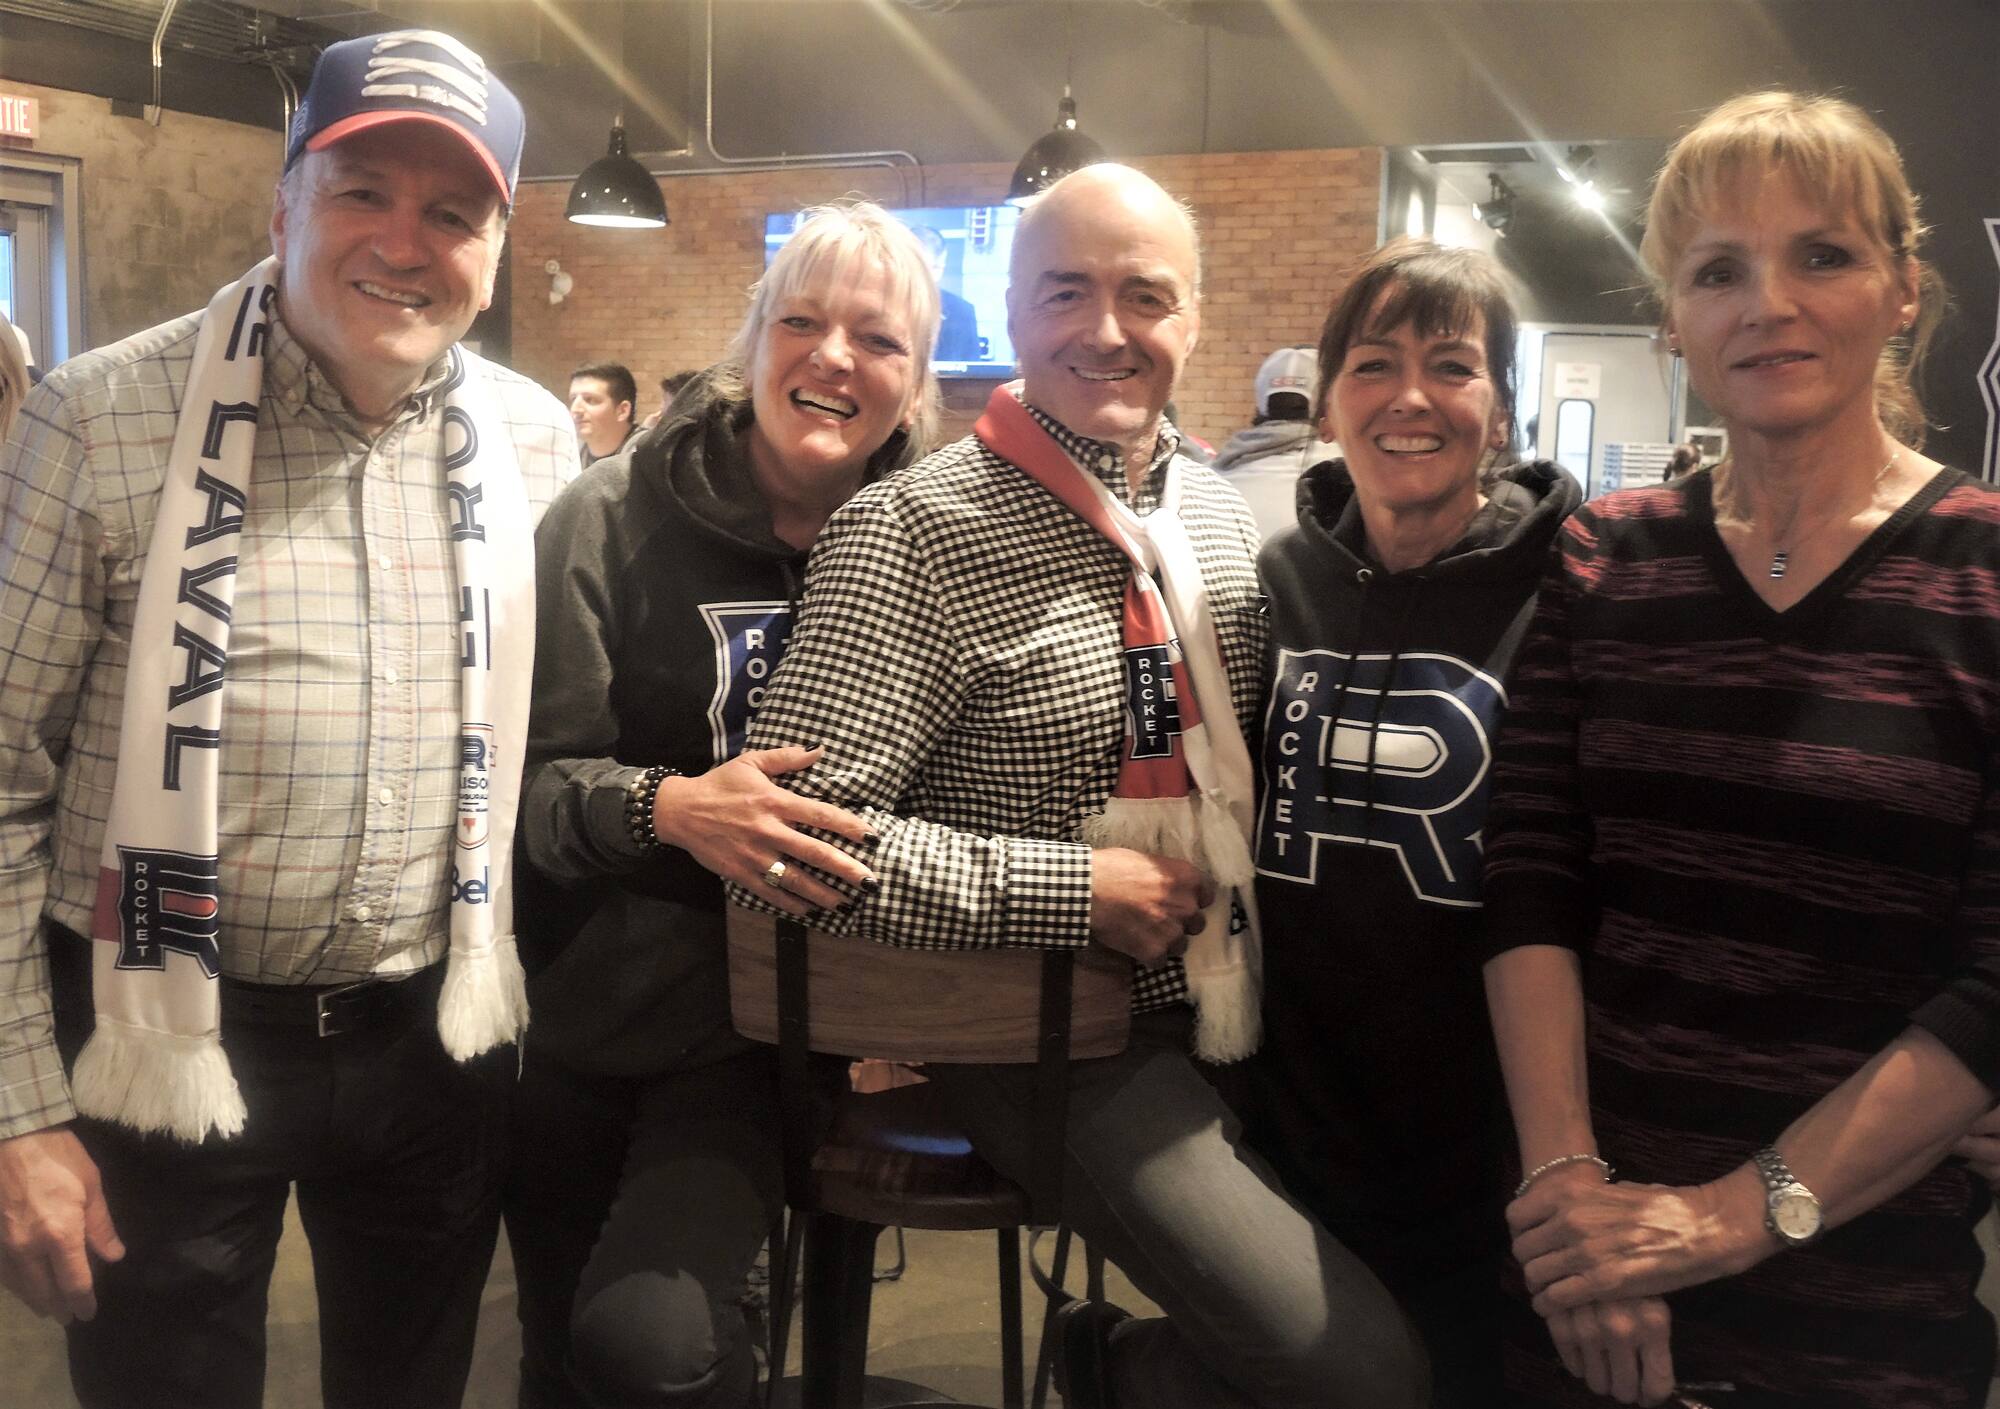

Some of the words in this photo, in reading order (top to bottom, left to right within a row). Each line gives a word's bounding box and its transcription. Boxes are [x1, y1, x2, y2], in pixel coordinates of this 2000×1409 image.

[0, 96, 32, 133] TIE
[163, 400, 258, 792] LAVAL
[1137, 657, 1158, 747] ROCKET
[1273, 671, 1319, 857] ROCKET
[134, 861, 149, 958] ROCKET
